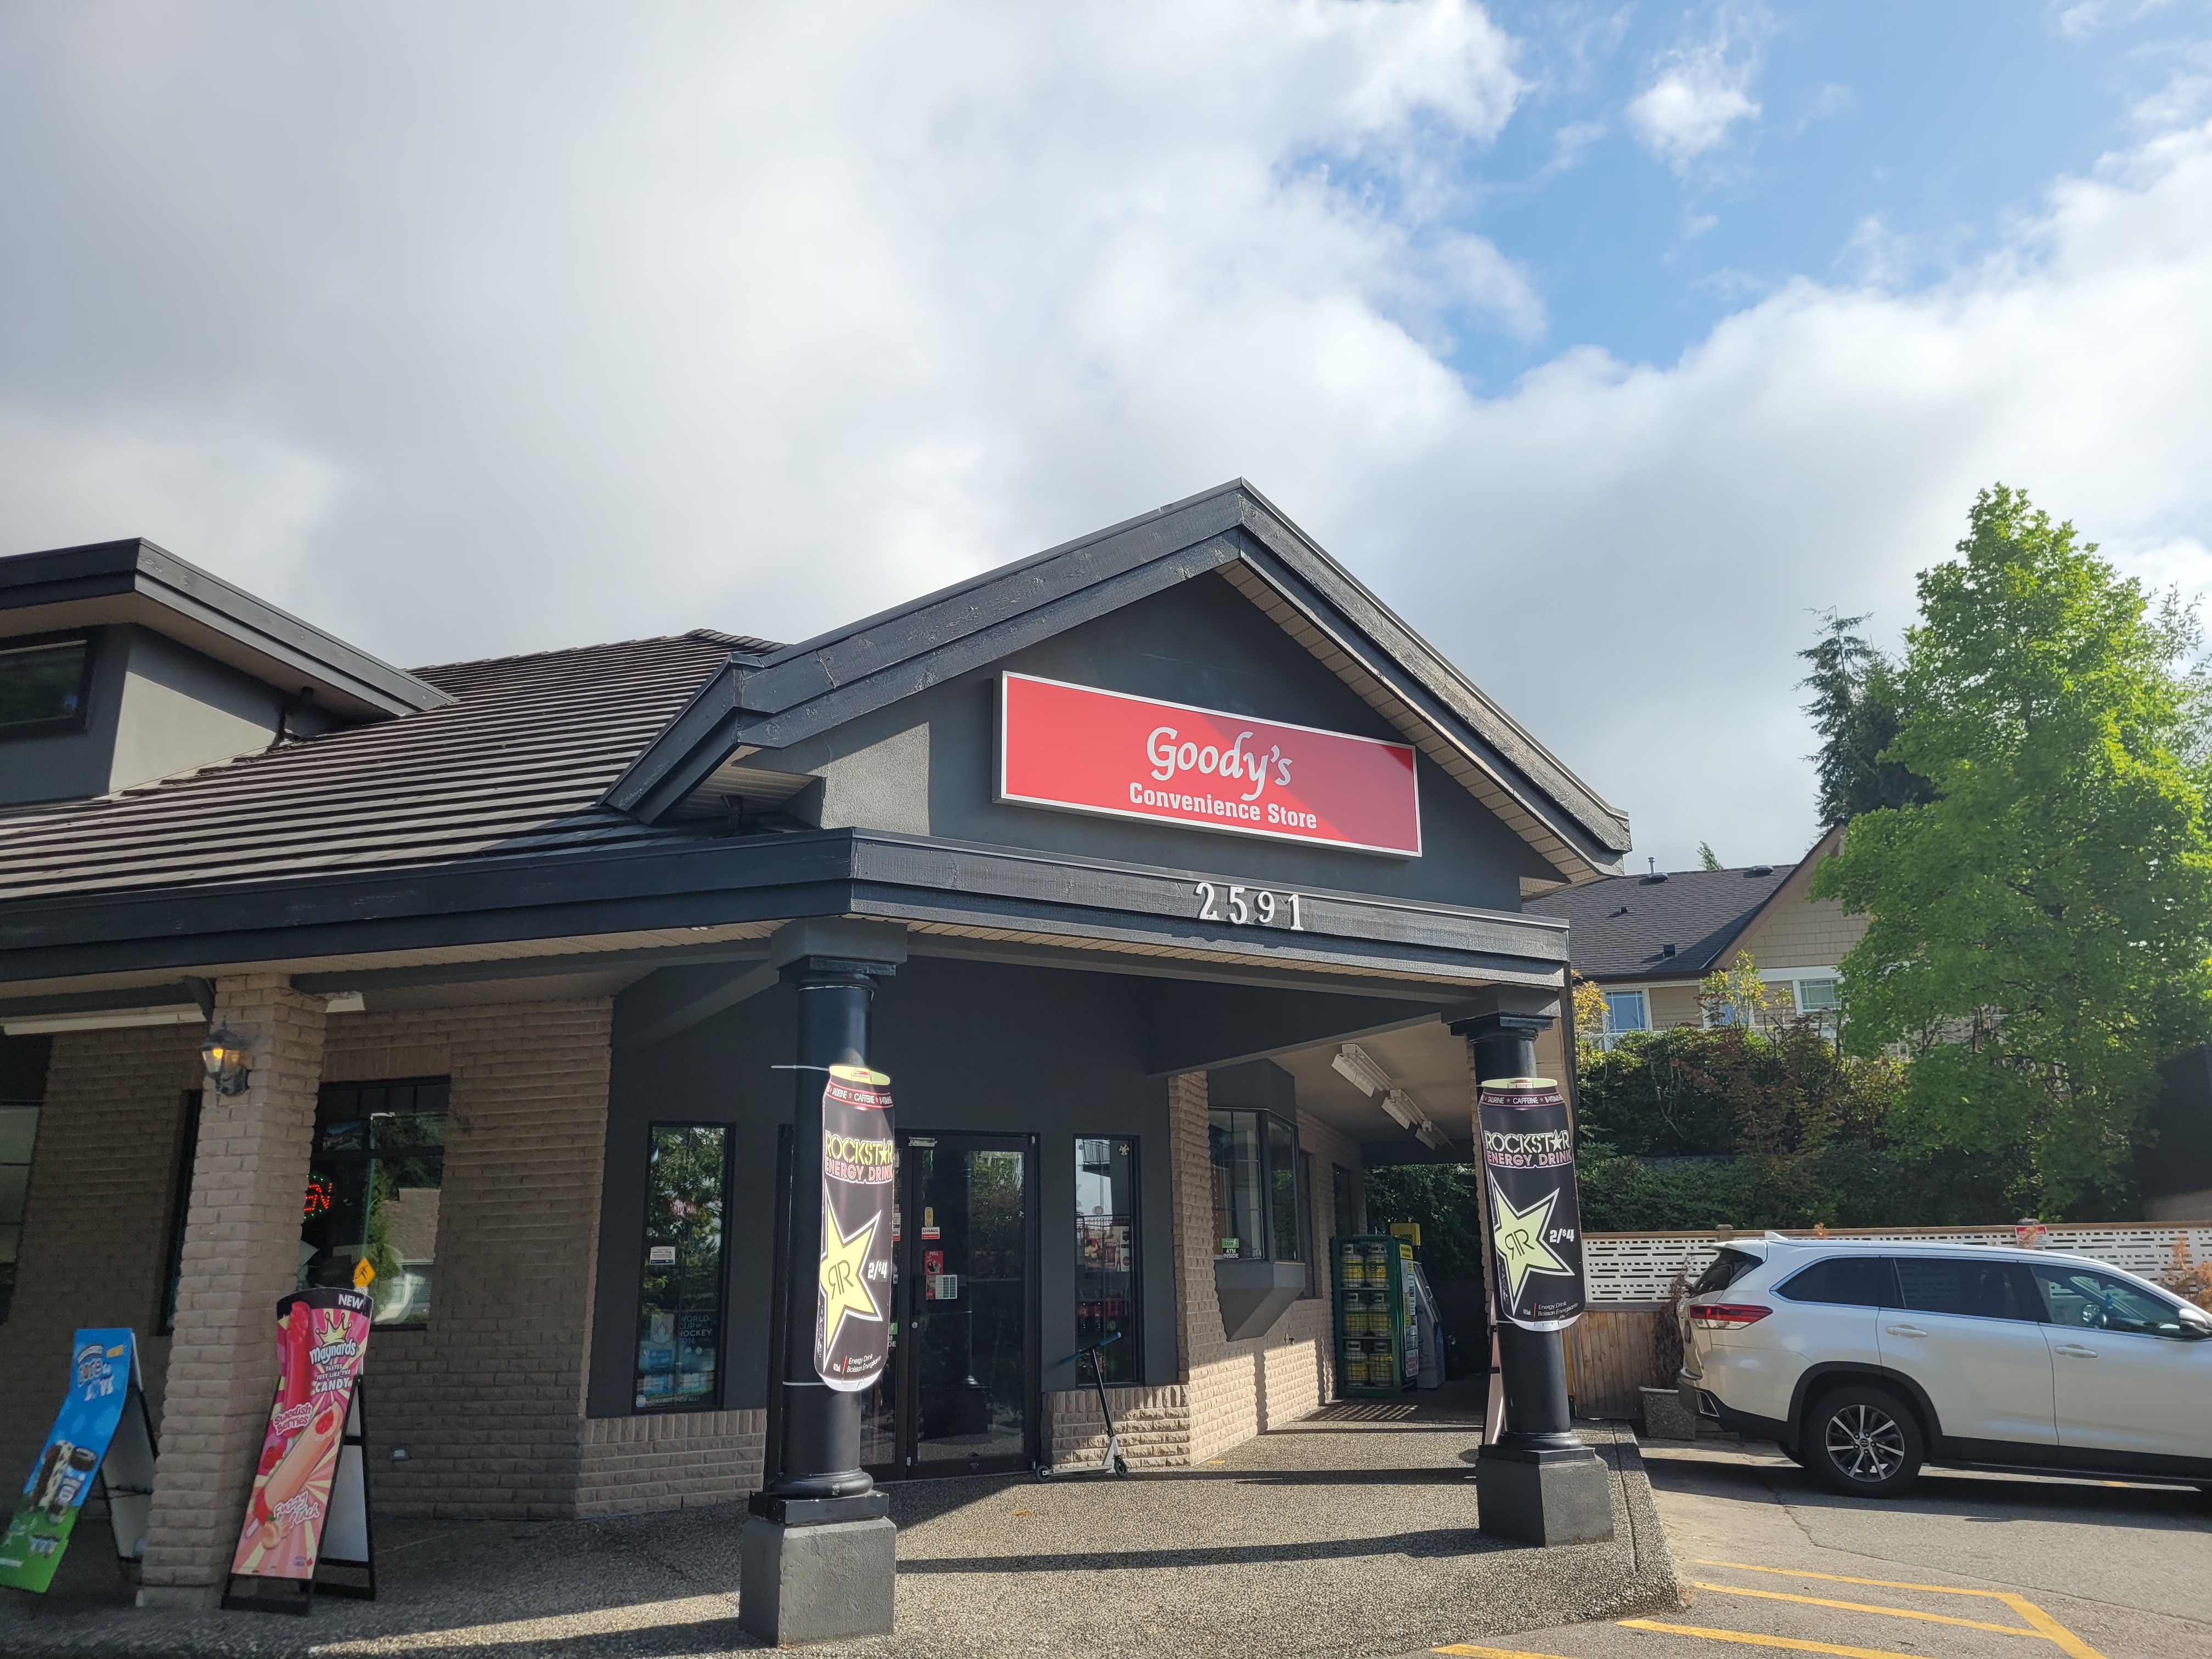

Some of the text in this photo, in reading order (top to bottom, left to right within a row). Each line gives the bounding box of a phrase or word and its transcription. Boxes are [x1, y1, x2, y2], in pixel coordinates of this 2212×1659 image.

[1147, 727, 1293, 801] Goody's
[1130, 782, 1317, 829] Convenience Store
[1195, 882, 1304, 931] 2591
[854, 1093, 875, 1104] CAFFEINE
[1487, 1150, 1572, 1166] ENERGY DRINK
[826, 1156, 893, 1181] ENERGY DRINK
[1549, 1228, 1575, 1243] 2/$4
[867, 1261, 888, 1280] 2/$4
[338, 1294, 364, 1309] NEW
[863, 1353, 873, 1363] Drink
[315, 1376, 350, 1392] CANDY
[274, 1403, 312, 1426] Swedish
[274, 1491, 308, 1519] Fuzzy
